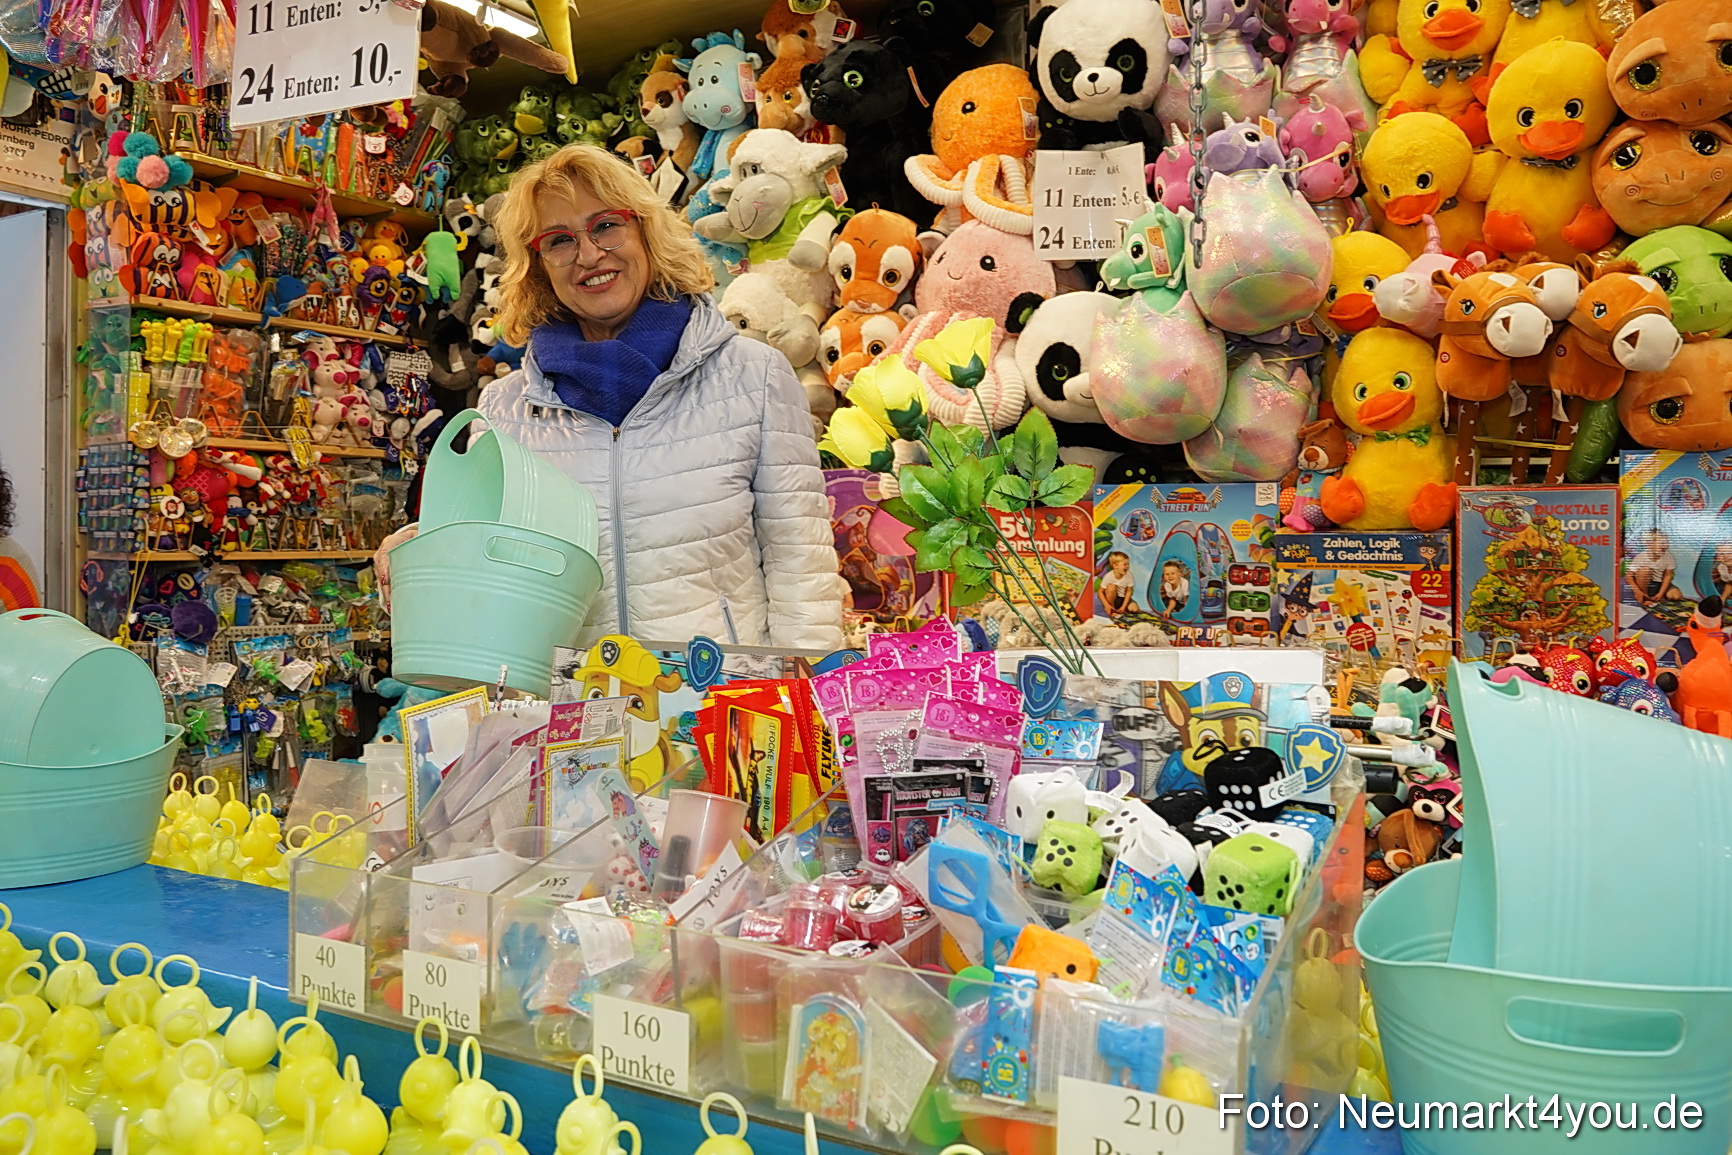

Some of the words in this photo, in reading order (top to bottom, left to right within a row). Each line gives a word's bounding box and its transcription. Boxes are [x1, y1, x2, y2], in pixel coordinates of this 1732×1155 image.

[248, 0, 274, 36] 11
[286, 1, 342, 29] Enten:
[237, 63, 275, 106] 24
[283, 75, 340, 100] Enten:
[350, 42, 402, 89] 10,-
[1075, 167, 1096, 176] Ente:
[1044, 188, 1064, 208] 11
[1072, 194, 1116, 208] Enten:
[1039, 226, 1065, 250] 24
[1072, 236, 1116, 250] Enten:
[1159, 503, 1190, 512] STREET
[1193, 503, 1211, 512] FUN
[1534, 504, 1609, 516] DUCKTALE
[1561, 519, 1610, 531] LOTTO
[1323, 537, 1365, 550] Zahlen,
[1369, 537, 1401, 550] Logik
[1569, 535, 1611, 546] GAME
[1325, 551, 1335, 561] &
[1337, 549, 1404, 562] Gedächtnis
[1421, 573, 1443, 587] 22
[766, 730, 777, 761] FOCKE
[763, 765, 773, 791] WULF
[763, 796, 771, 811] 190
[315, 945, 336, 968] 40
[425, 961, 447, 988] 80
[408, 993, 470, 1030] Punkte
[623, 1010, 661, 1043] 160
[600, 1045, 676, 1087] Punkte
[1123, 1095, 1185, 1136] 210
